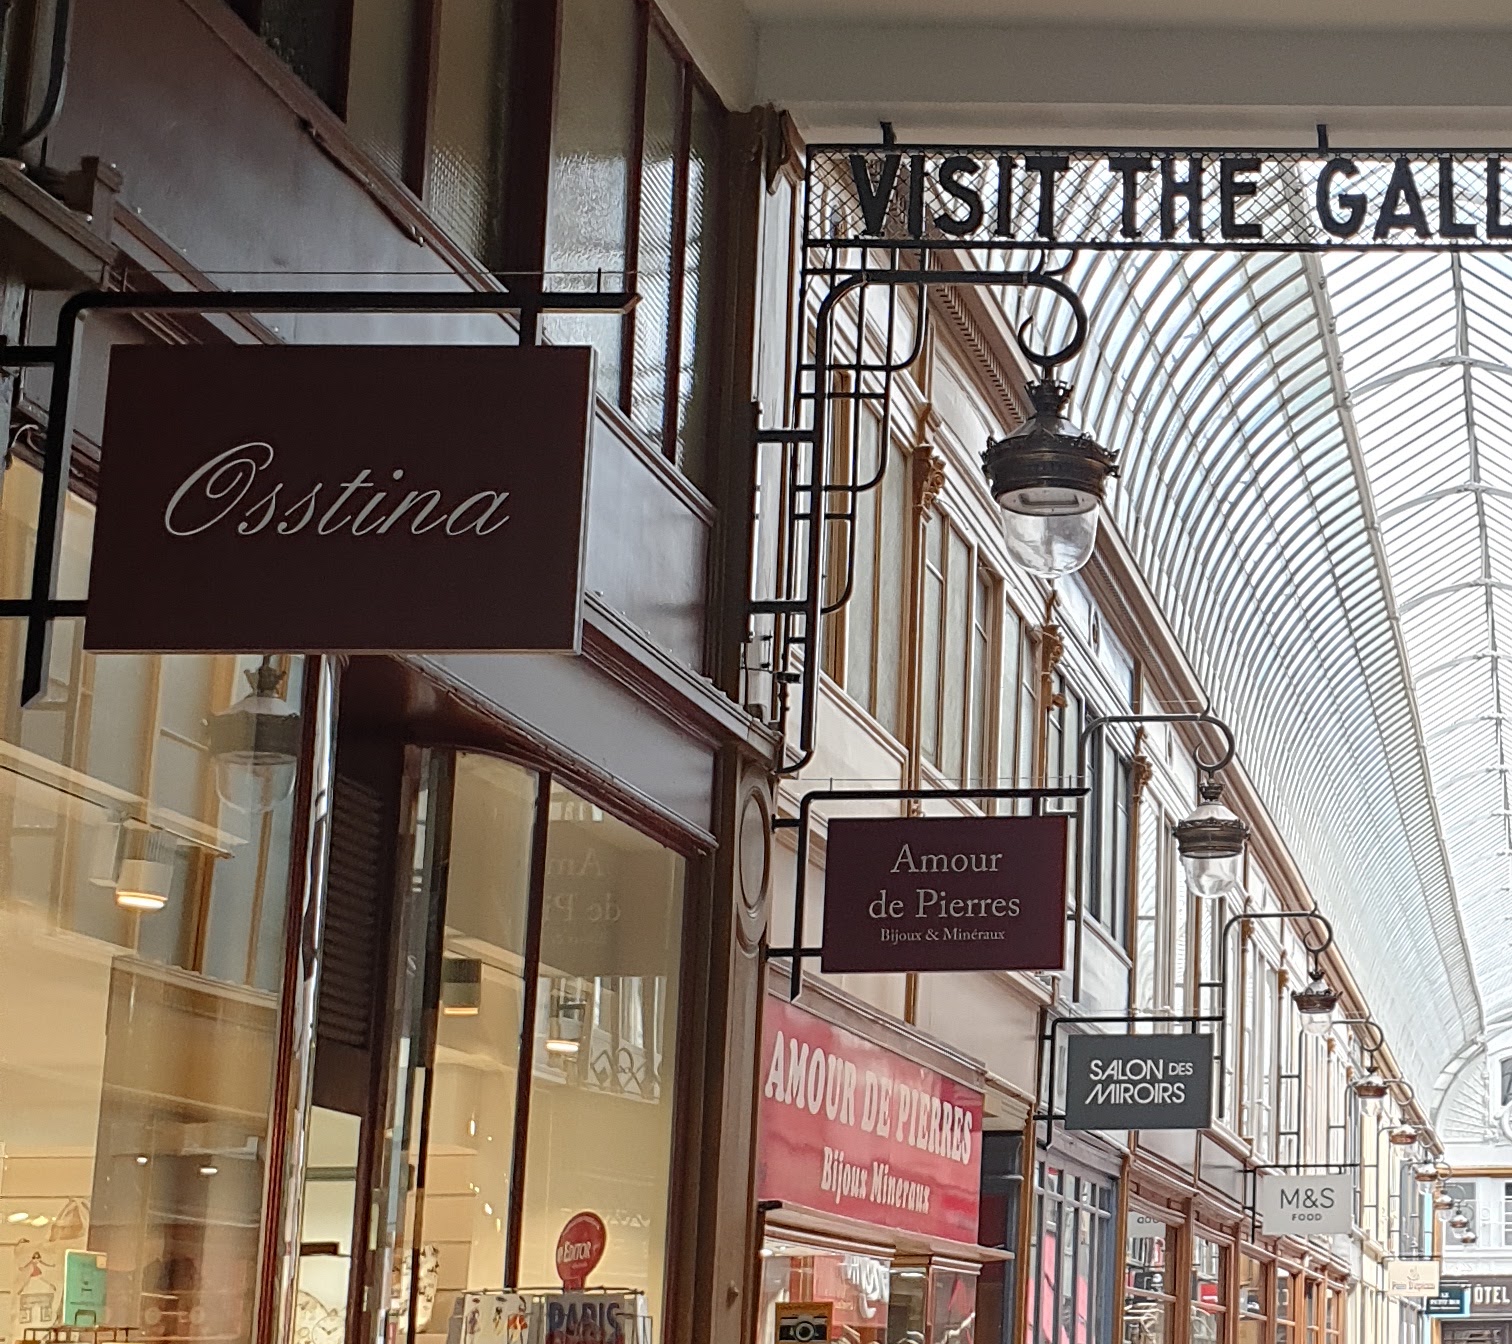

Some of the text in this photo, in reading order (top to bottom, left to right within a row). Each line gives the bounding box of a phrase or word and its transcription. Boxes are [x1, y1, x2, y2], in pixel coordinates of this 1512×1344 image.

[847, 153, 1072, 239] VISIT
[1106, 153, 1266, 238] THE
[164, 441, 511, 537] Osstina
[890, 843, 1003, 873] Amour
[868, 888, 1021, 919] de Pierres
[880, 927, 1005, 946] Bijoux & Minéraux
[1089, 1059, 1194, 1081] SALON DES
[764, 1030, 973, 1166] AMOUR DE PIERRES
[1084, 1082, 1186, 1105] MIROIRS
[820, 1146, 931, 1214] Bijoux Mineraux
[1280, 1187, 1335, 1209] M&S
[1291, 1213, 1323, 1222] FOOD
[1474, 1284, 1511, 1304] ÔTEL
